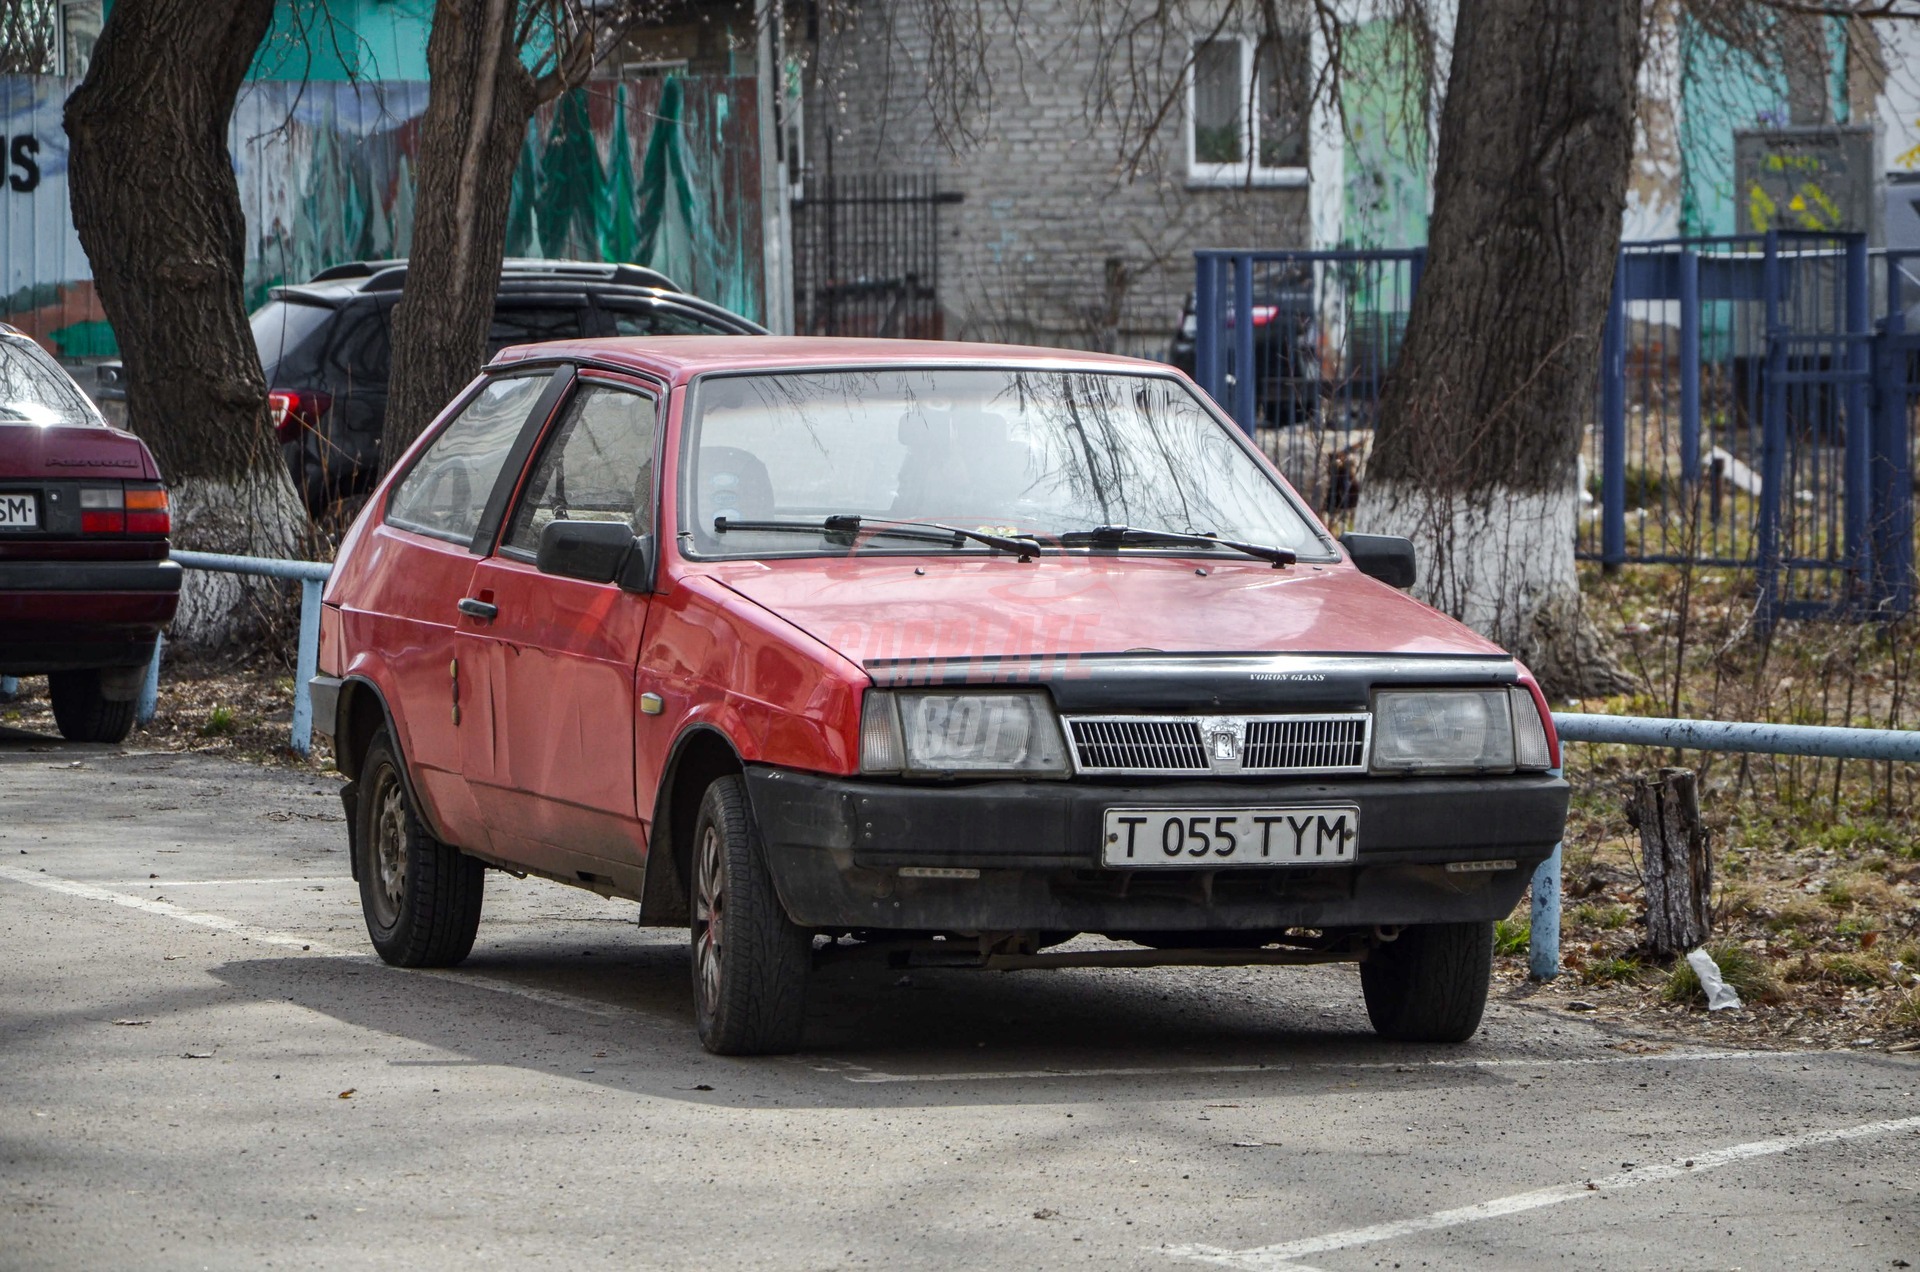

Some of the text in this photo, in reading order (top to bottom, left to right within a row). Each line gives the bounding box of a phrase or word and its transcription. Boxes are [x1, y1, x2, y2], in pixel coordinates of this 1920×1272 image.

[1250, 673, 1326, 682] VORON GLASS
[1118, 815, 1346, 857] T 055 TYM
